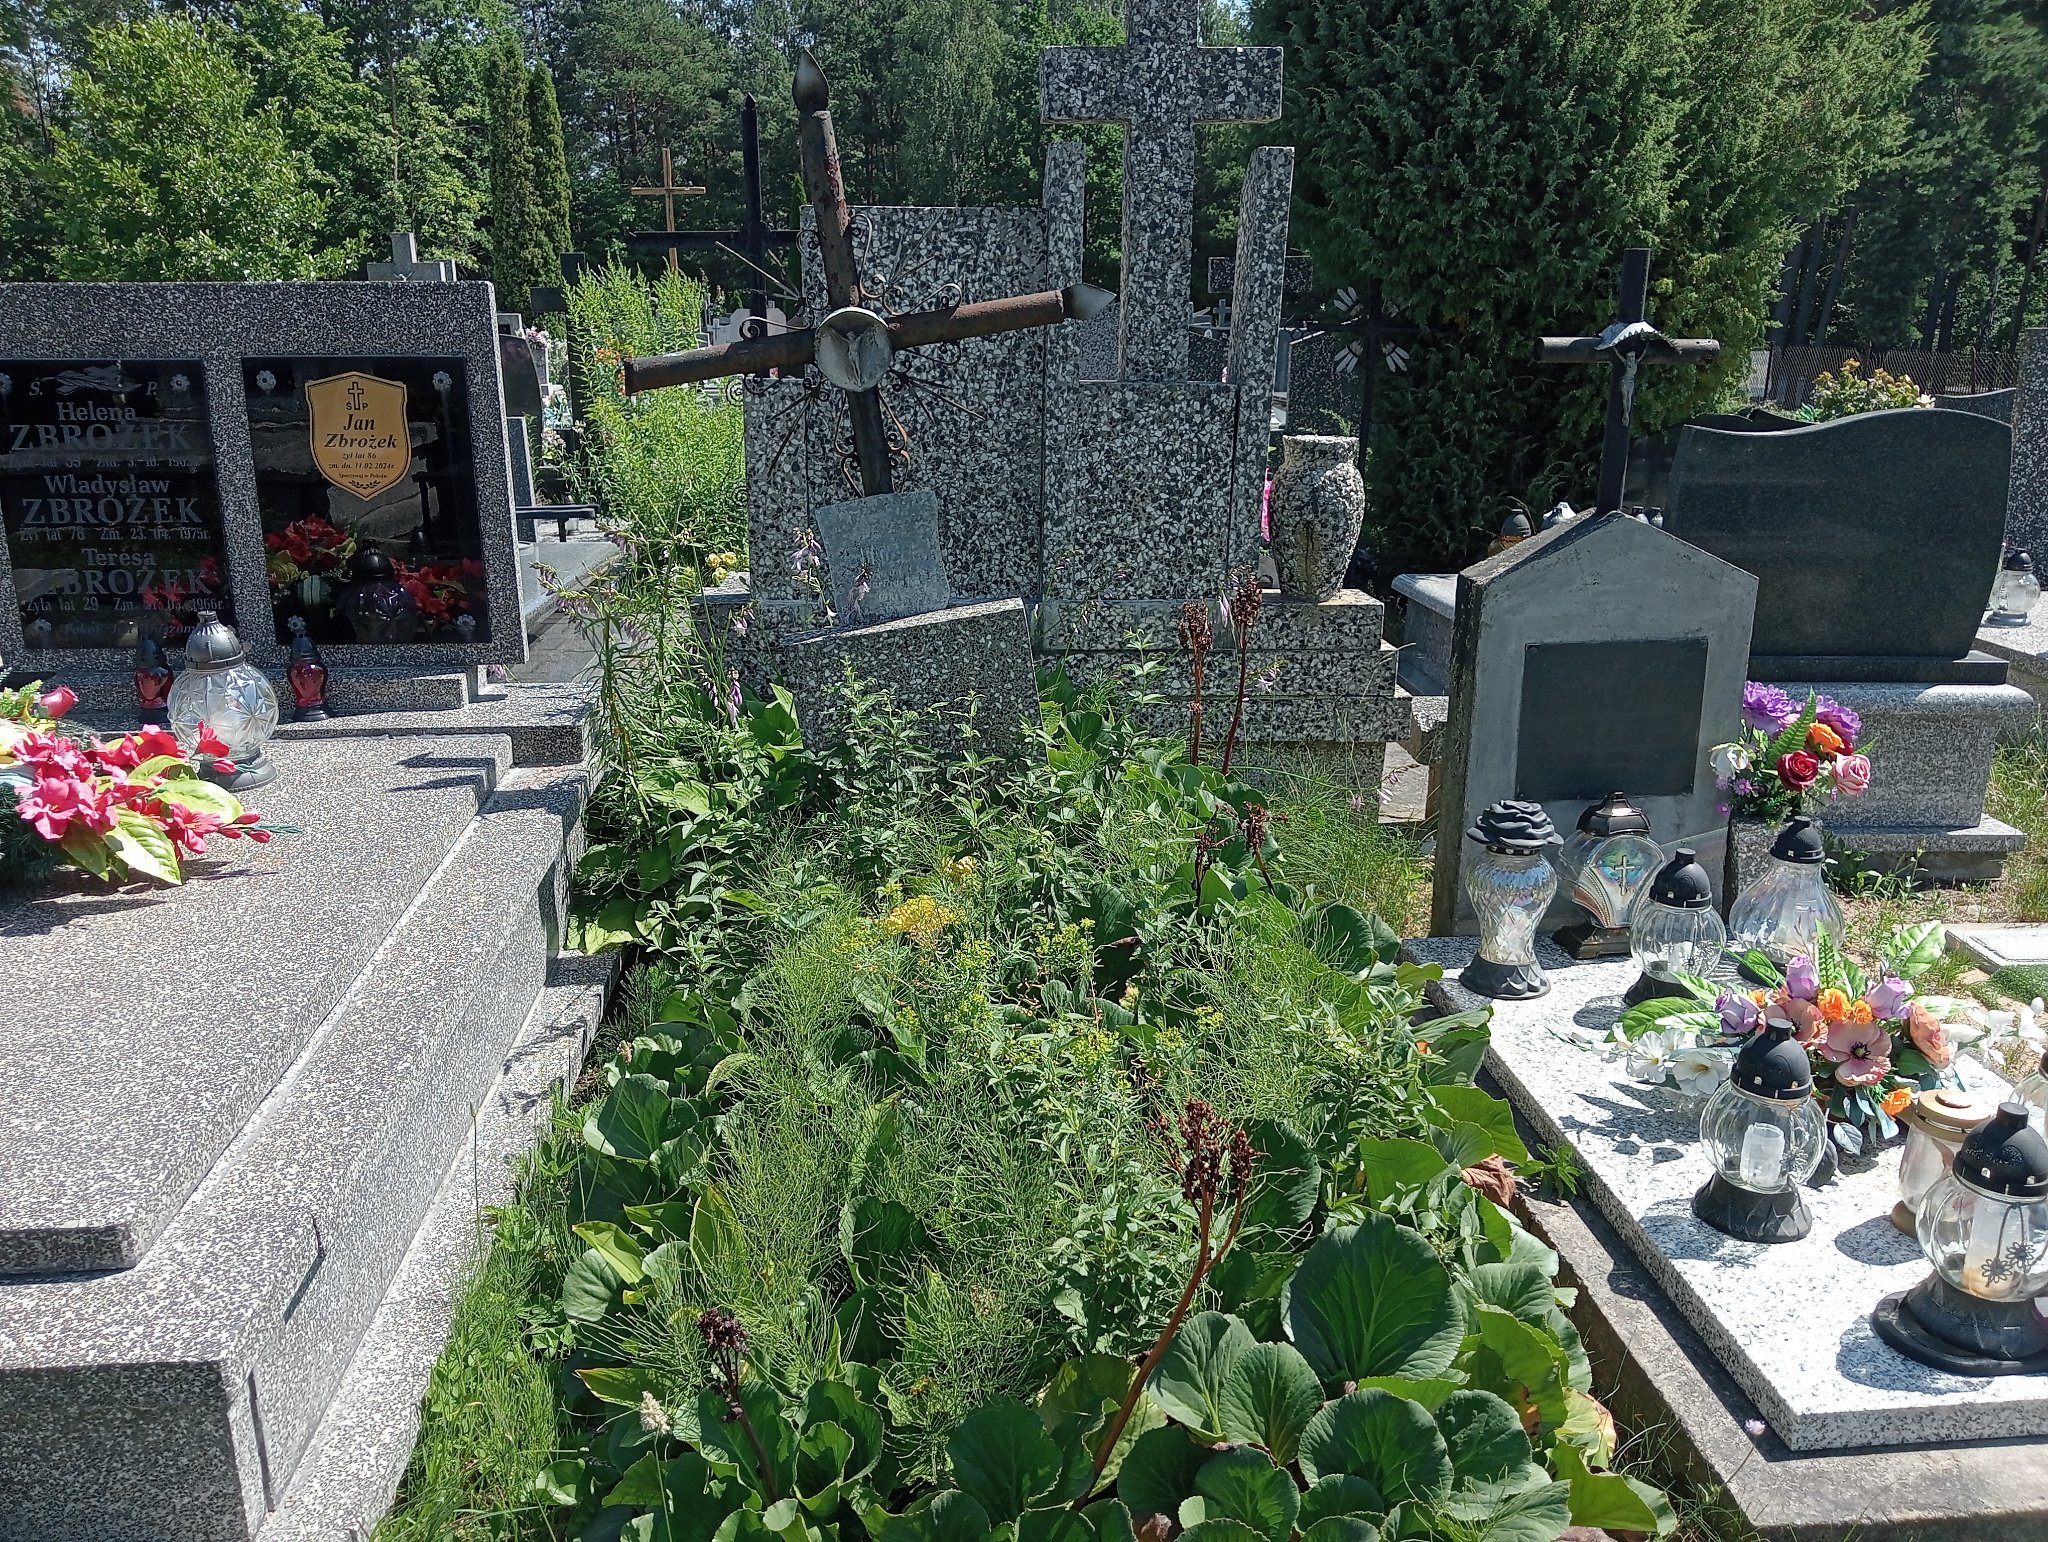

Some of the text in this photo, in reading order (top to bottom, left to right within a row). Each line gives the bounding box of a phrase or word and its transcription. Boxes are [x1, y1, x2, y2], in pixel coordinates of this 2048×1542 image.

[56, 400, 136, 421] Helena
[362, 402, 369, 411] P
[343, 414, 375, 431] Jan
[324, 434, 397, 449] Zbrożek
[43, 473, 170, 498] Władysław
[22, 494, 203, 524] ZBROŻEK
[130, 527, 147, 540] 23.
[81, 547, 157, 566] Teresa
[46, 566, 212, 595] BROŻEK
[82, 596, 99, 611] 29
